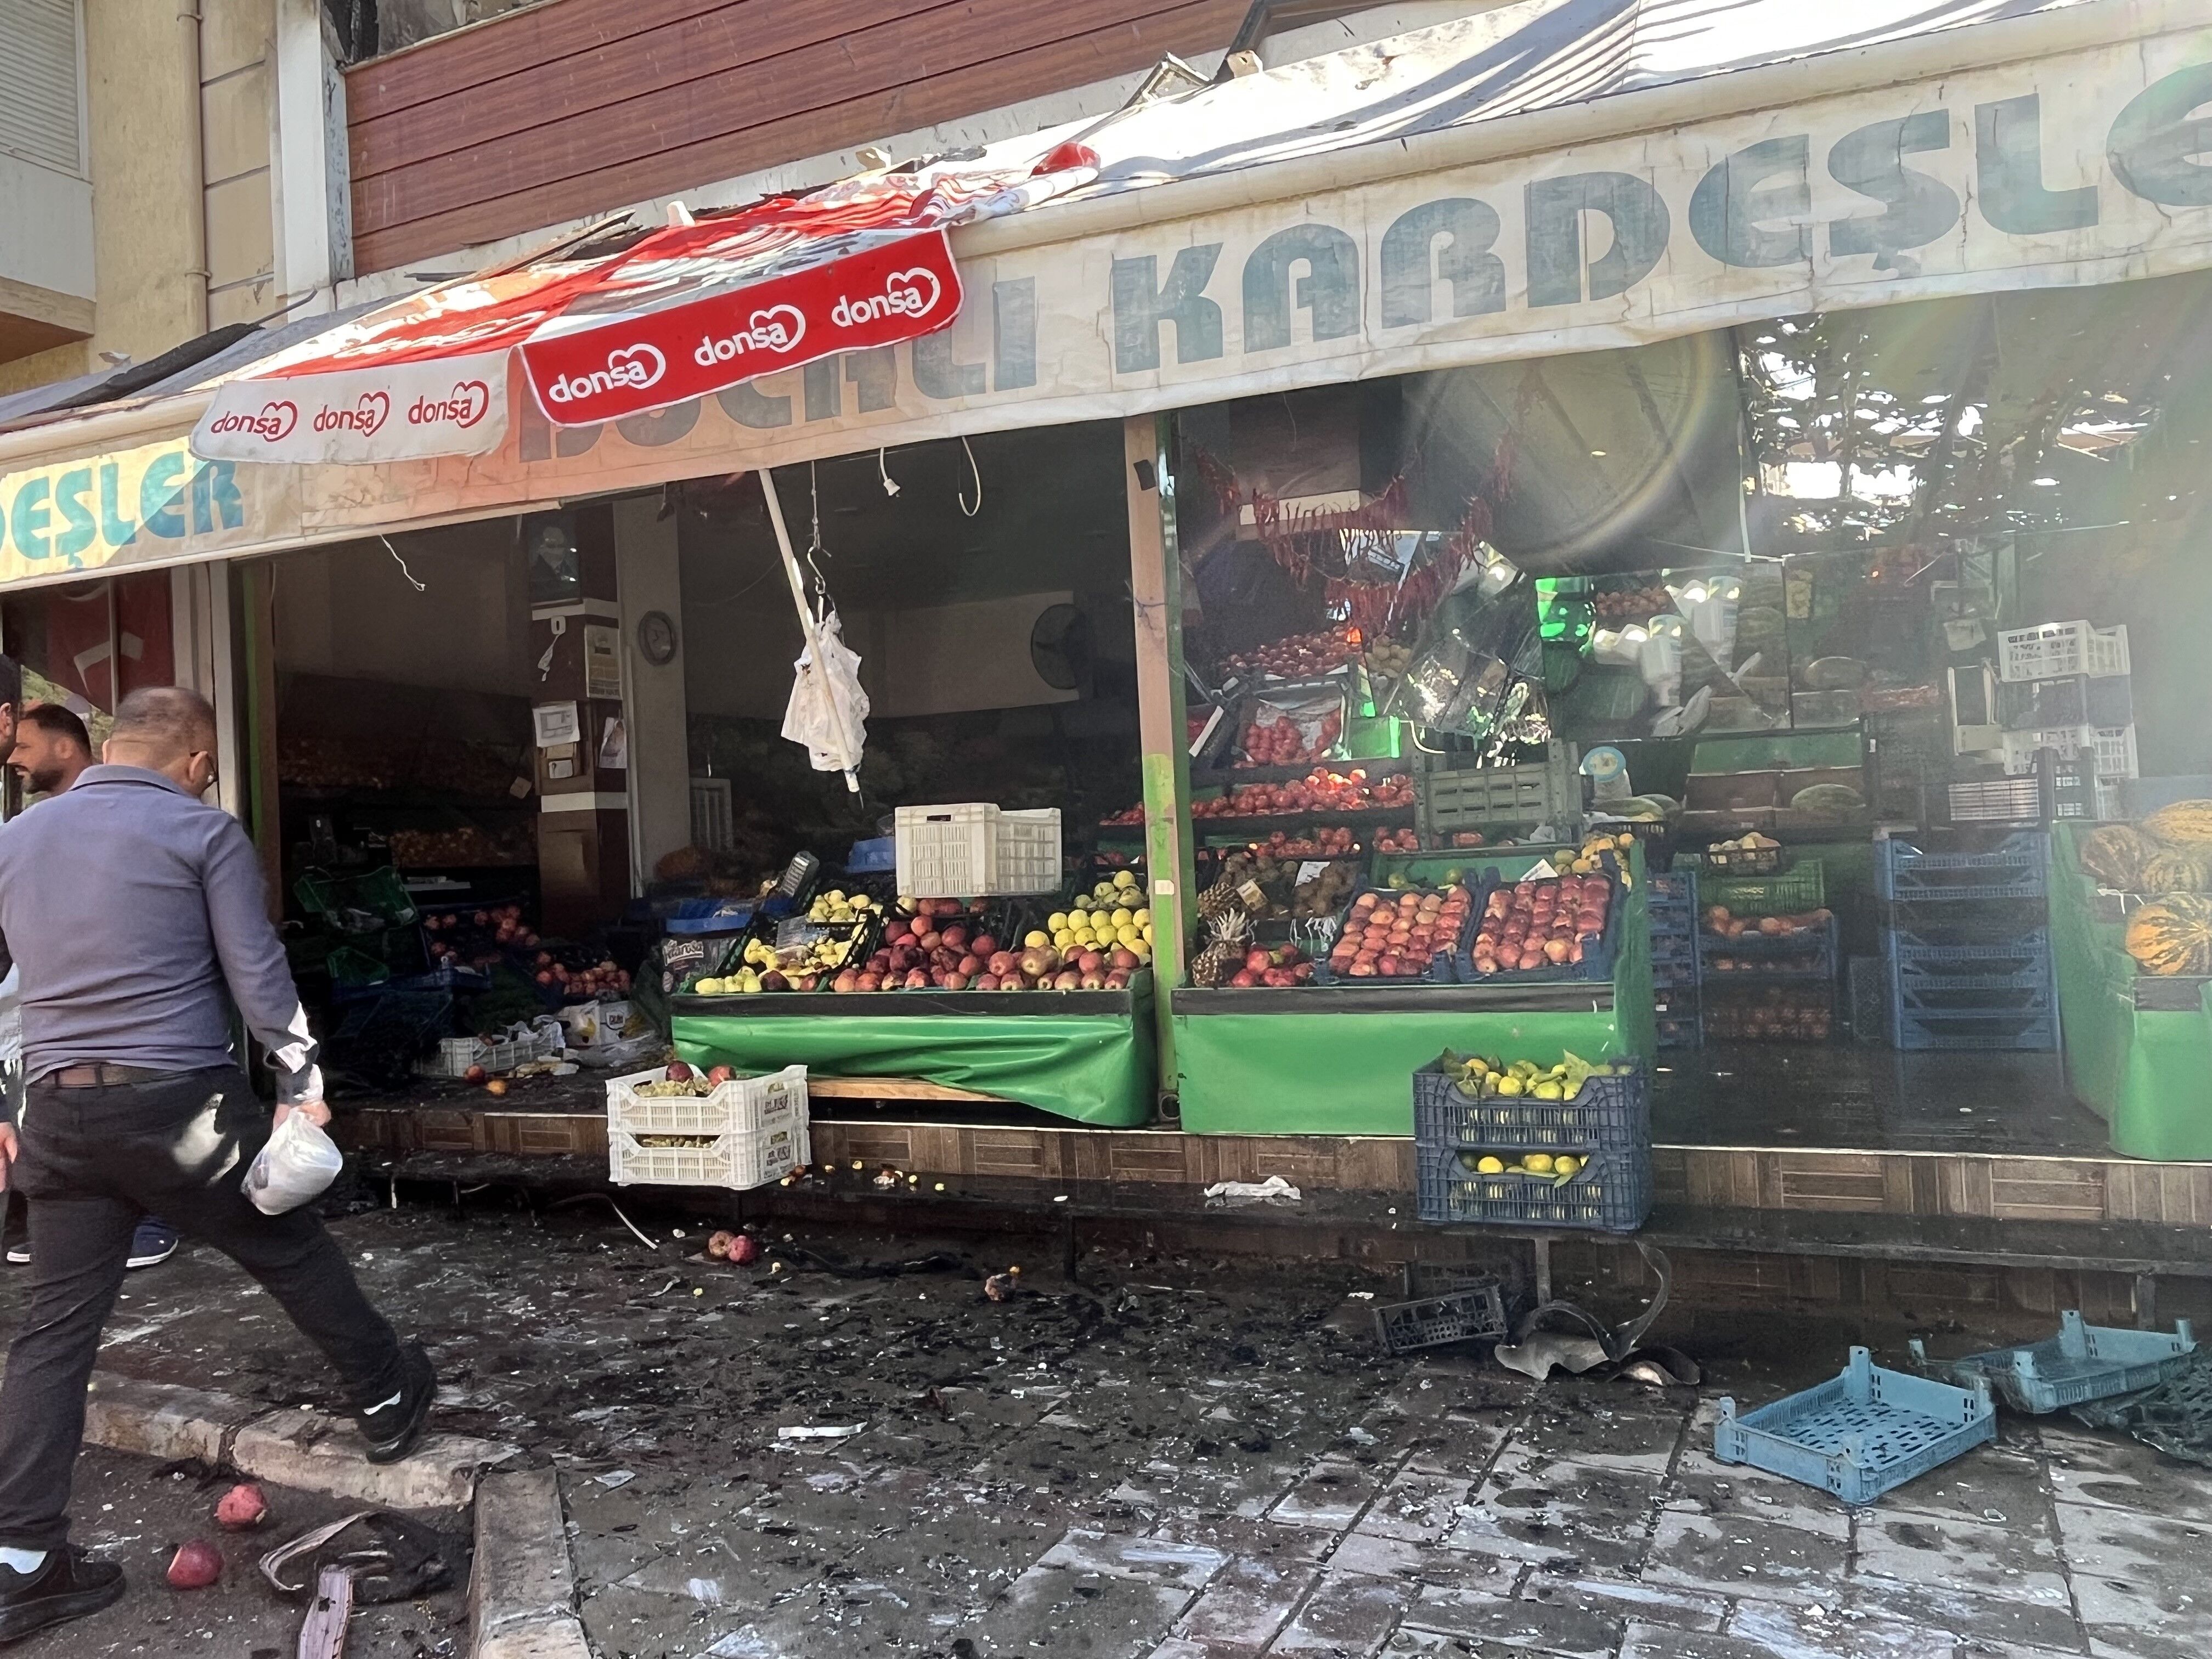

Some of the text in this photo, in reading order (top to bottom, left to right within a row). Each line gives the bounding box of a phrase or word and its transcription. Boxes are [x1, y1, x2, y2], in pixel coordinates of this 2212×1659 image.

[549, 286, 922, 403] donsa donsa donsa
[210, 394, 473, 435] donsa donsa donsa
[0, 451, 244, 569] EŞLER
